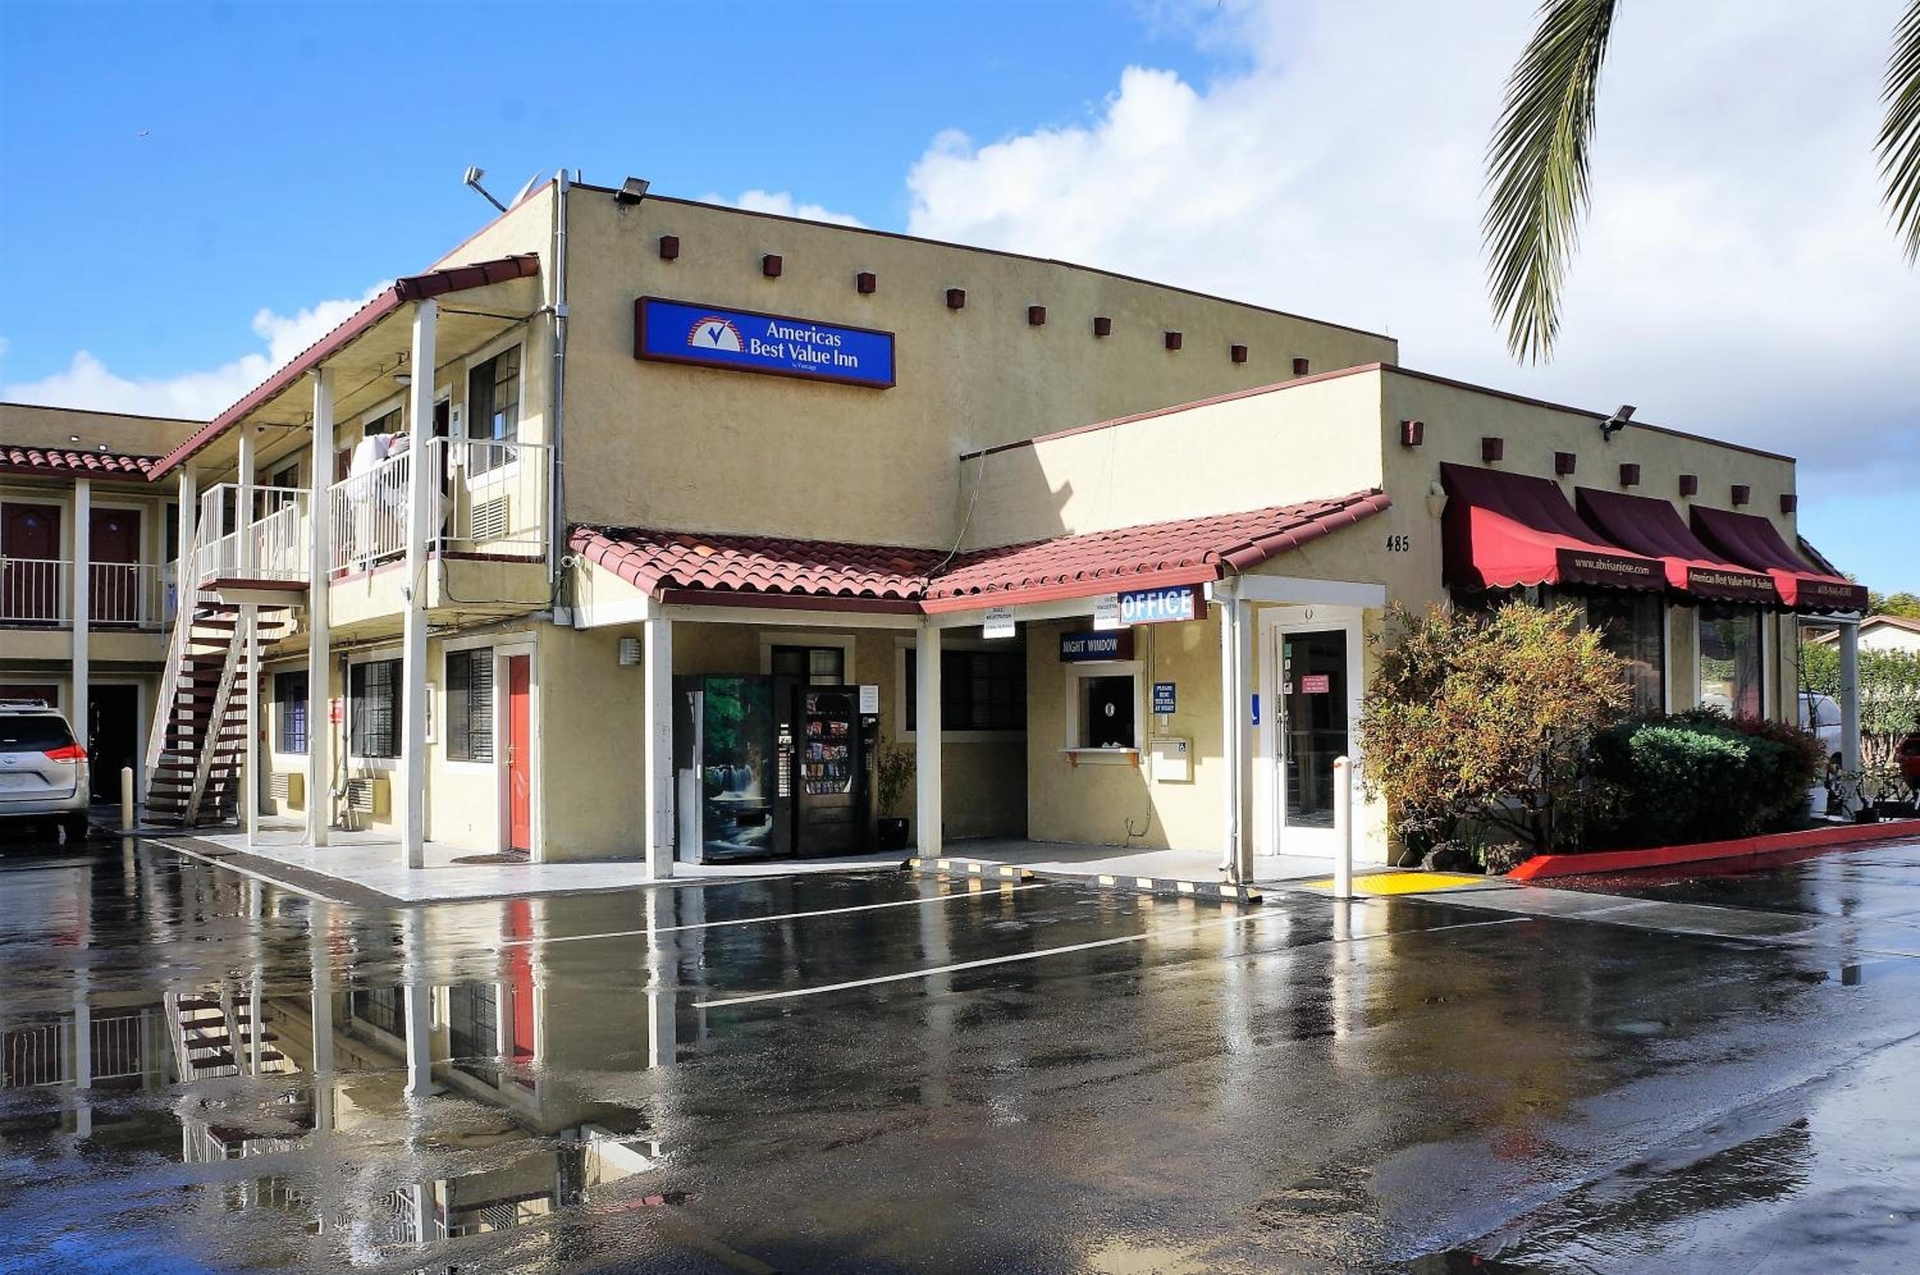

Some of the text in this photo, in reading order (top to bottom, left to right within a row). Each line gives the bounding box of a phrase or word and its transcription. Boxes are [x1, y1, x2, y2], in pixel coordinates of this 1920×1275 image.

[766, 321, 842, 347] Americas
[750, 338, 858, 368] Best Value Inn
[1386, 534, 1409, 552] 485
[1689, 571, 1715, 584] Americas
[1715, 574, 1727, 585] Best
[1728, 575, 1743, 586] Value
[1743, 576, 1752, 587] Inn
[1758, 579, 1773, 590] Suites
[1122, 589, 1191, 619] OFFICE
[1063, 638, 1118, 654] NIGHT WINDOW
